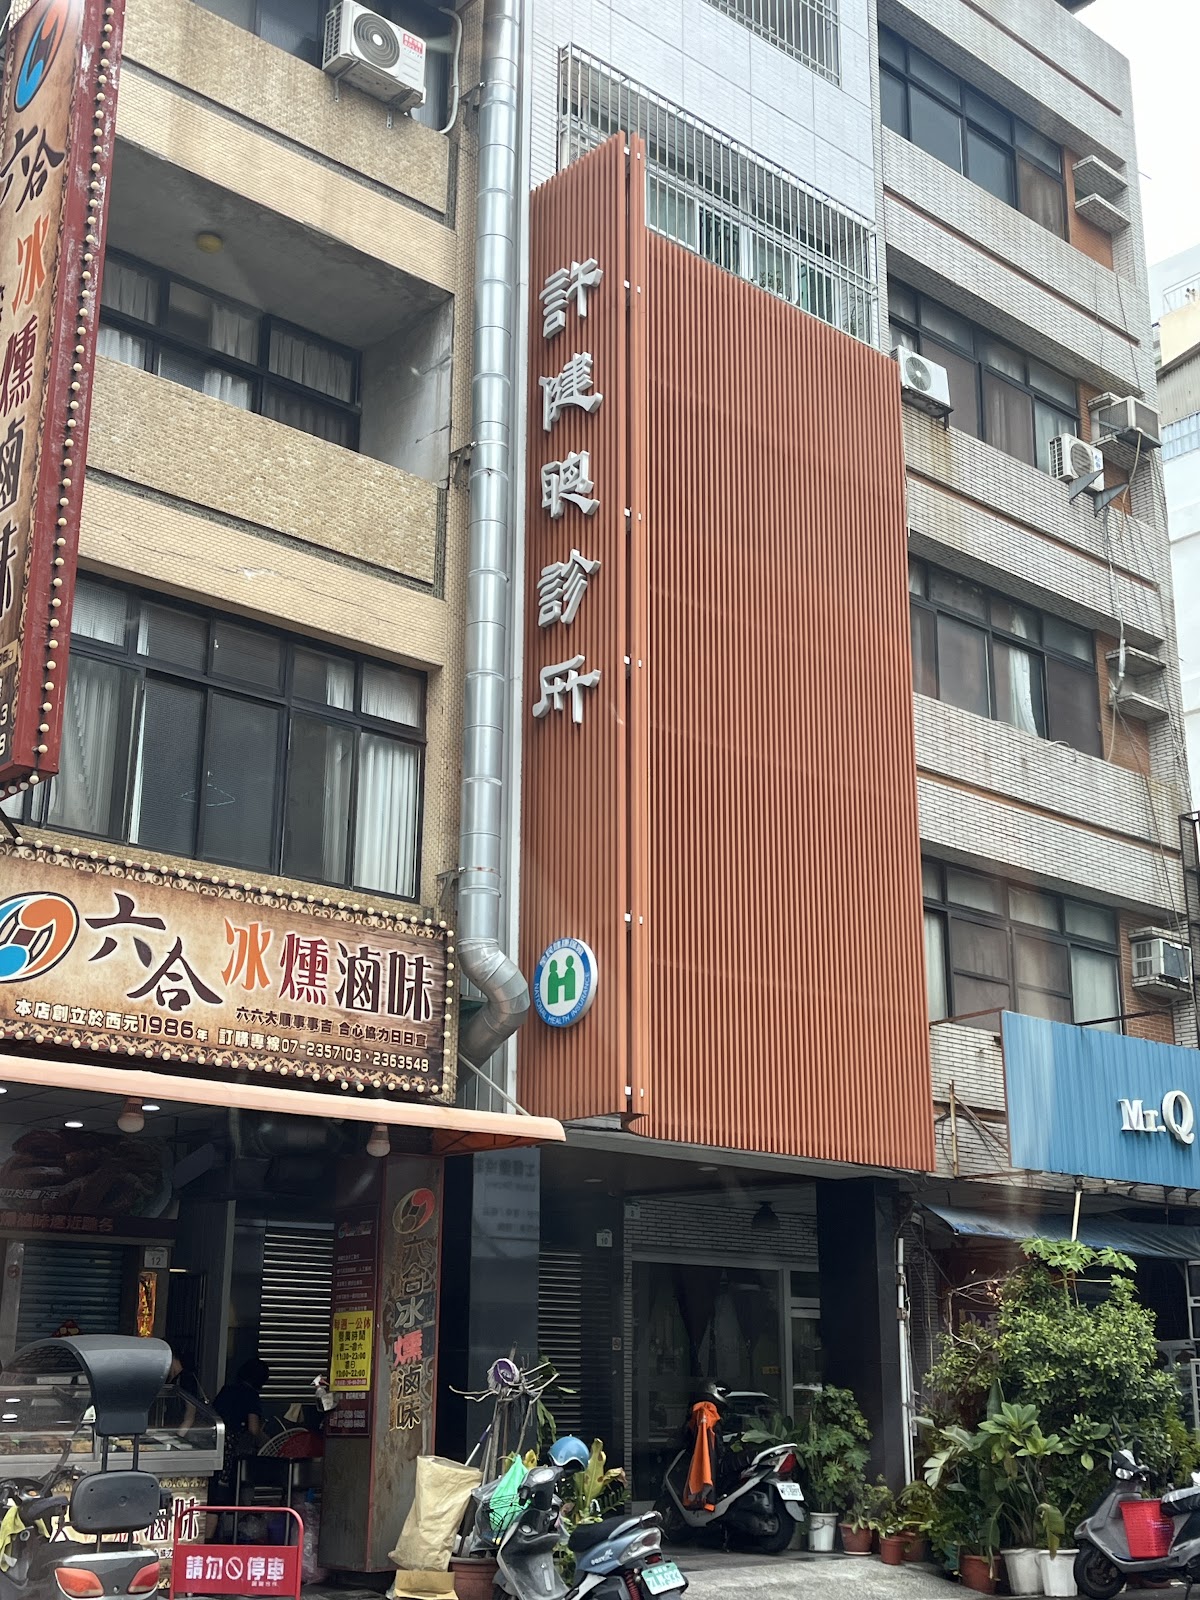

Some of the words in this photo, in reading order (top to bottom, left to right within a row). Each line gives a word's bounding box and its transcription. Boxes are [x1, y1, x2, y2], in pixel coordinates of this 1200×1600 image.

[85, 892, 433, 1022] 六合冰燻滷味
[237, 1007, 333, 1034] 六六大順事事吉
[534, 982, 547, 1019] NATIONAL
[547, 1015, 570, 1025] HEALTH
[151, 1257, 161, 1266] 12
[394, 1236, 430, 1430] 六合冰燻滷味
[185, 1555, 223, 1580] 請勿
[247, 1556, 284, 1581] 停車
